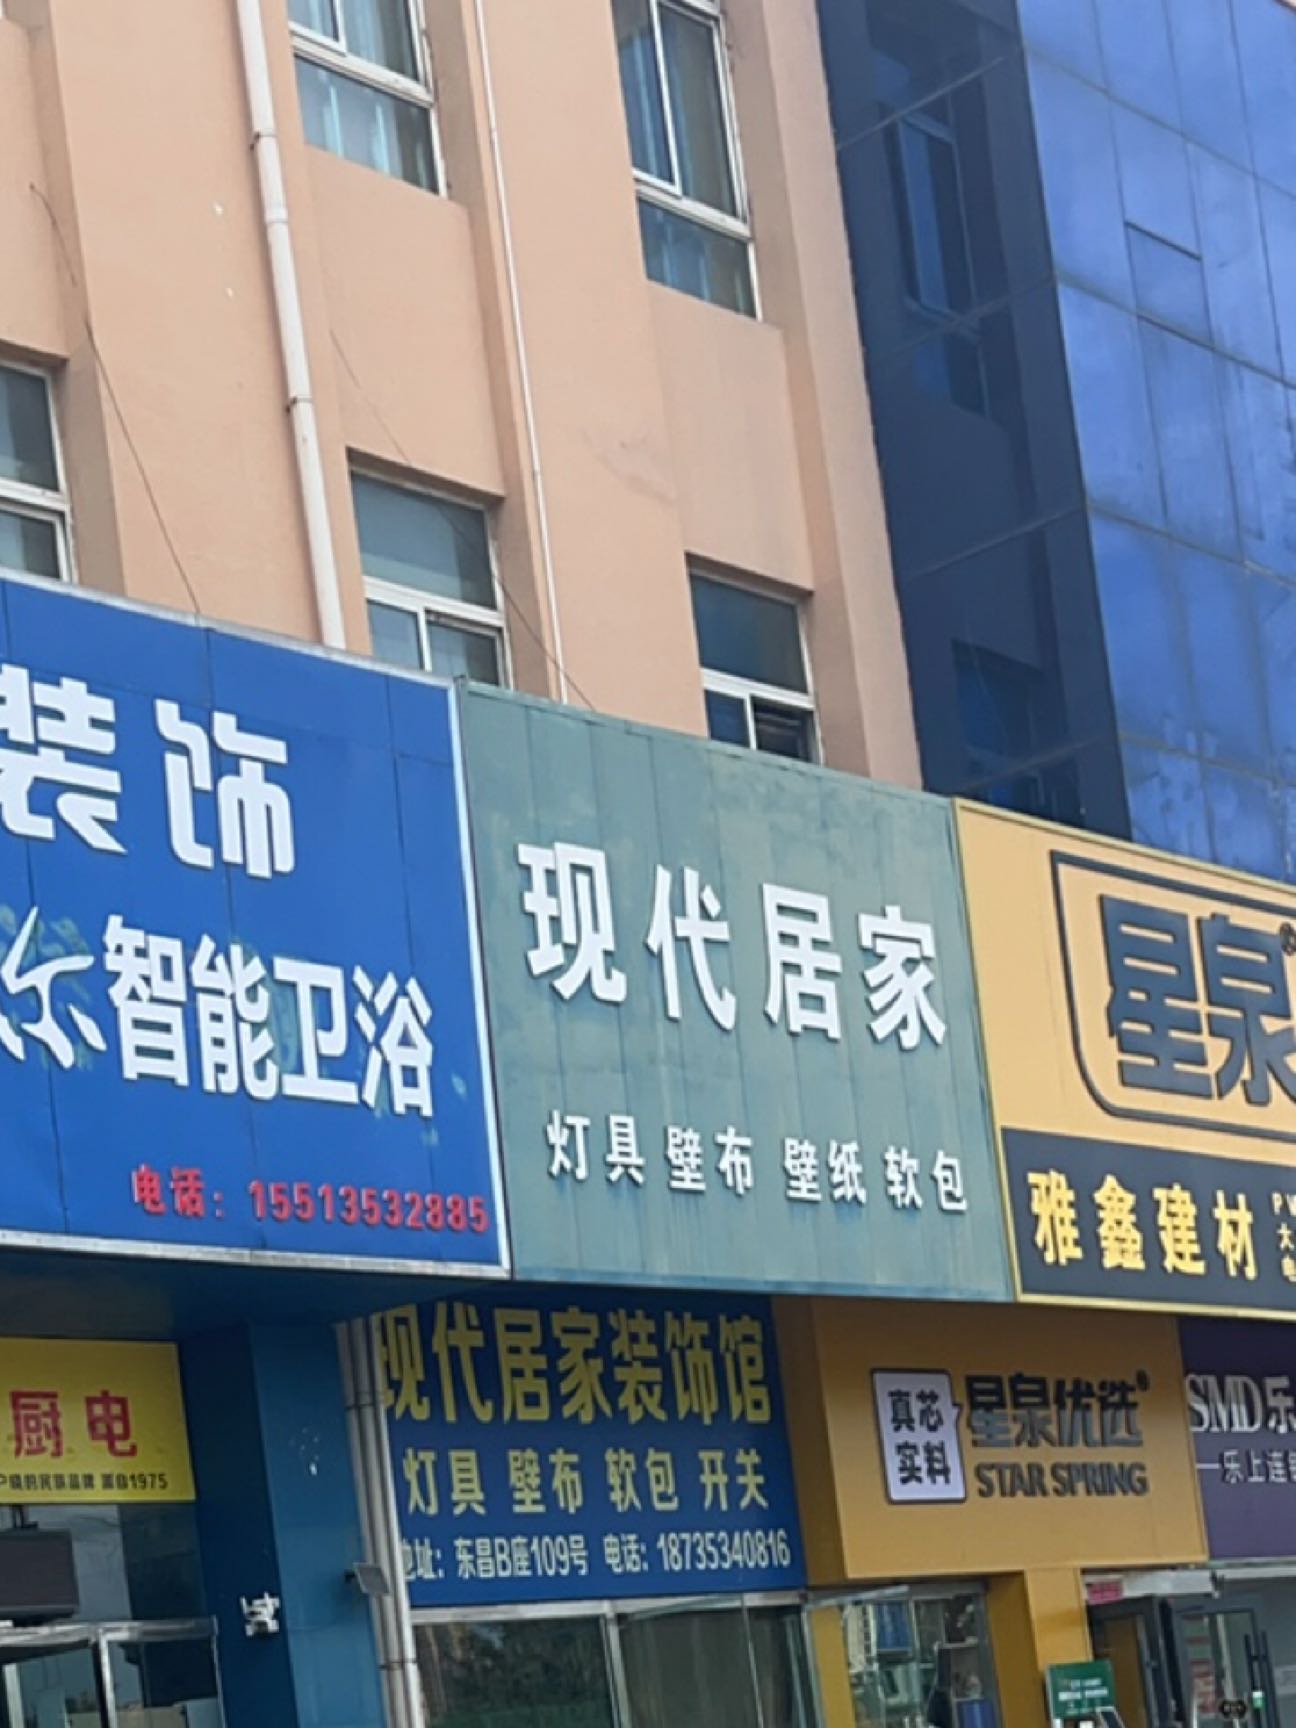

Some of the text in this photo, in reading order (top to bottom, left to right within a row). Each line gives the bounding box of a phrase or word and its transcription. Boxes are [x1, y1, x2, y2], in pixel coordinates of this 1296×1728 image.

[517, 840, 948, 1050] 现代居家
[545, 1110, 969, 1214] 灯具 壁布 壁纸 软包
[248, 1178, 491, 1234] 15513532885
[1027, 1168, 1259, 1281] 雅鑫建材
[380, 1301, 773, 1426] 现代居家装饰馆
[888, 1388, 945, 1434] 真芯
[964, 1372, 1146, 1449] 星泉优选
[402, 1446, 768, 1519] 灯具 壁布 软包 开关
[896, 1440, 952, 1487] 实料
[977, 1461, 1149, 1500] STAR SPRING
[453, 1531, 588, 1580] 东昌B座109号
[656, 1526, 791, 1572] 18735340816
